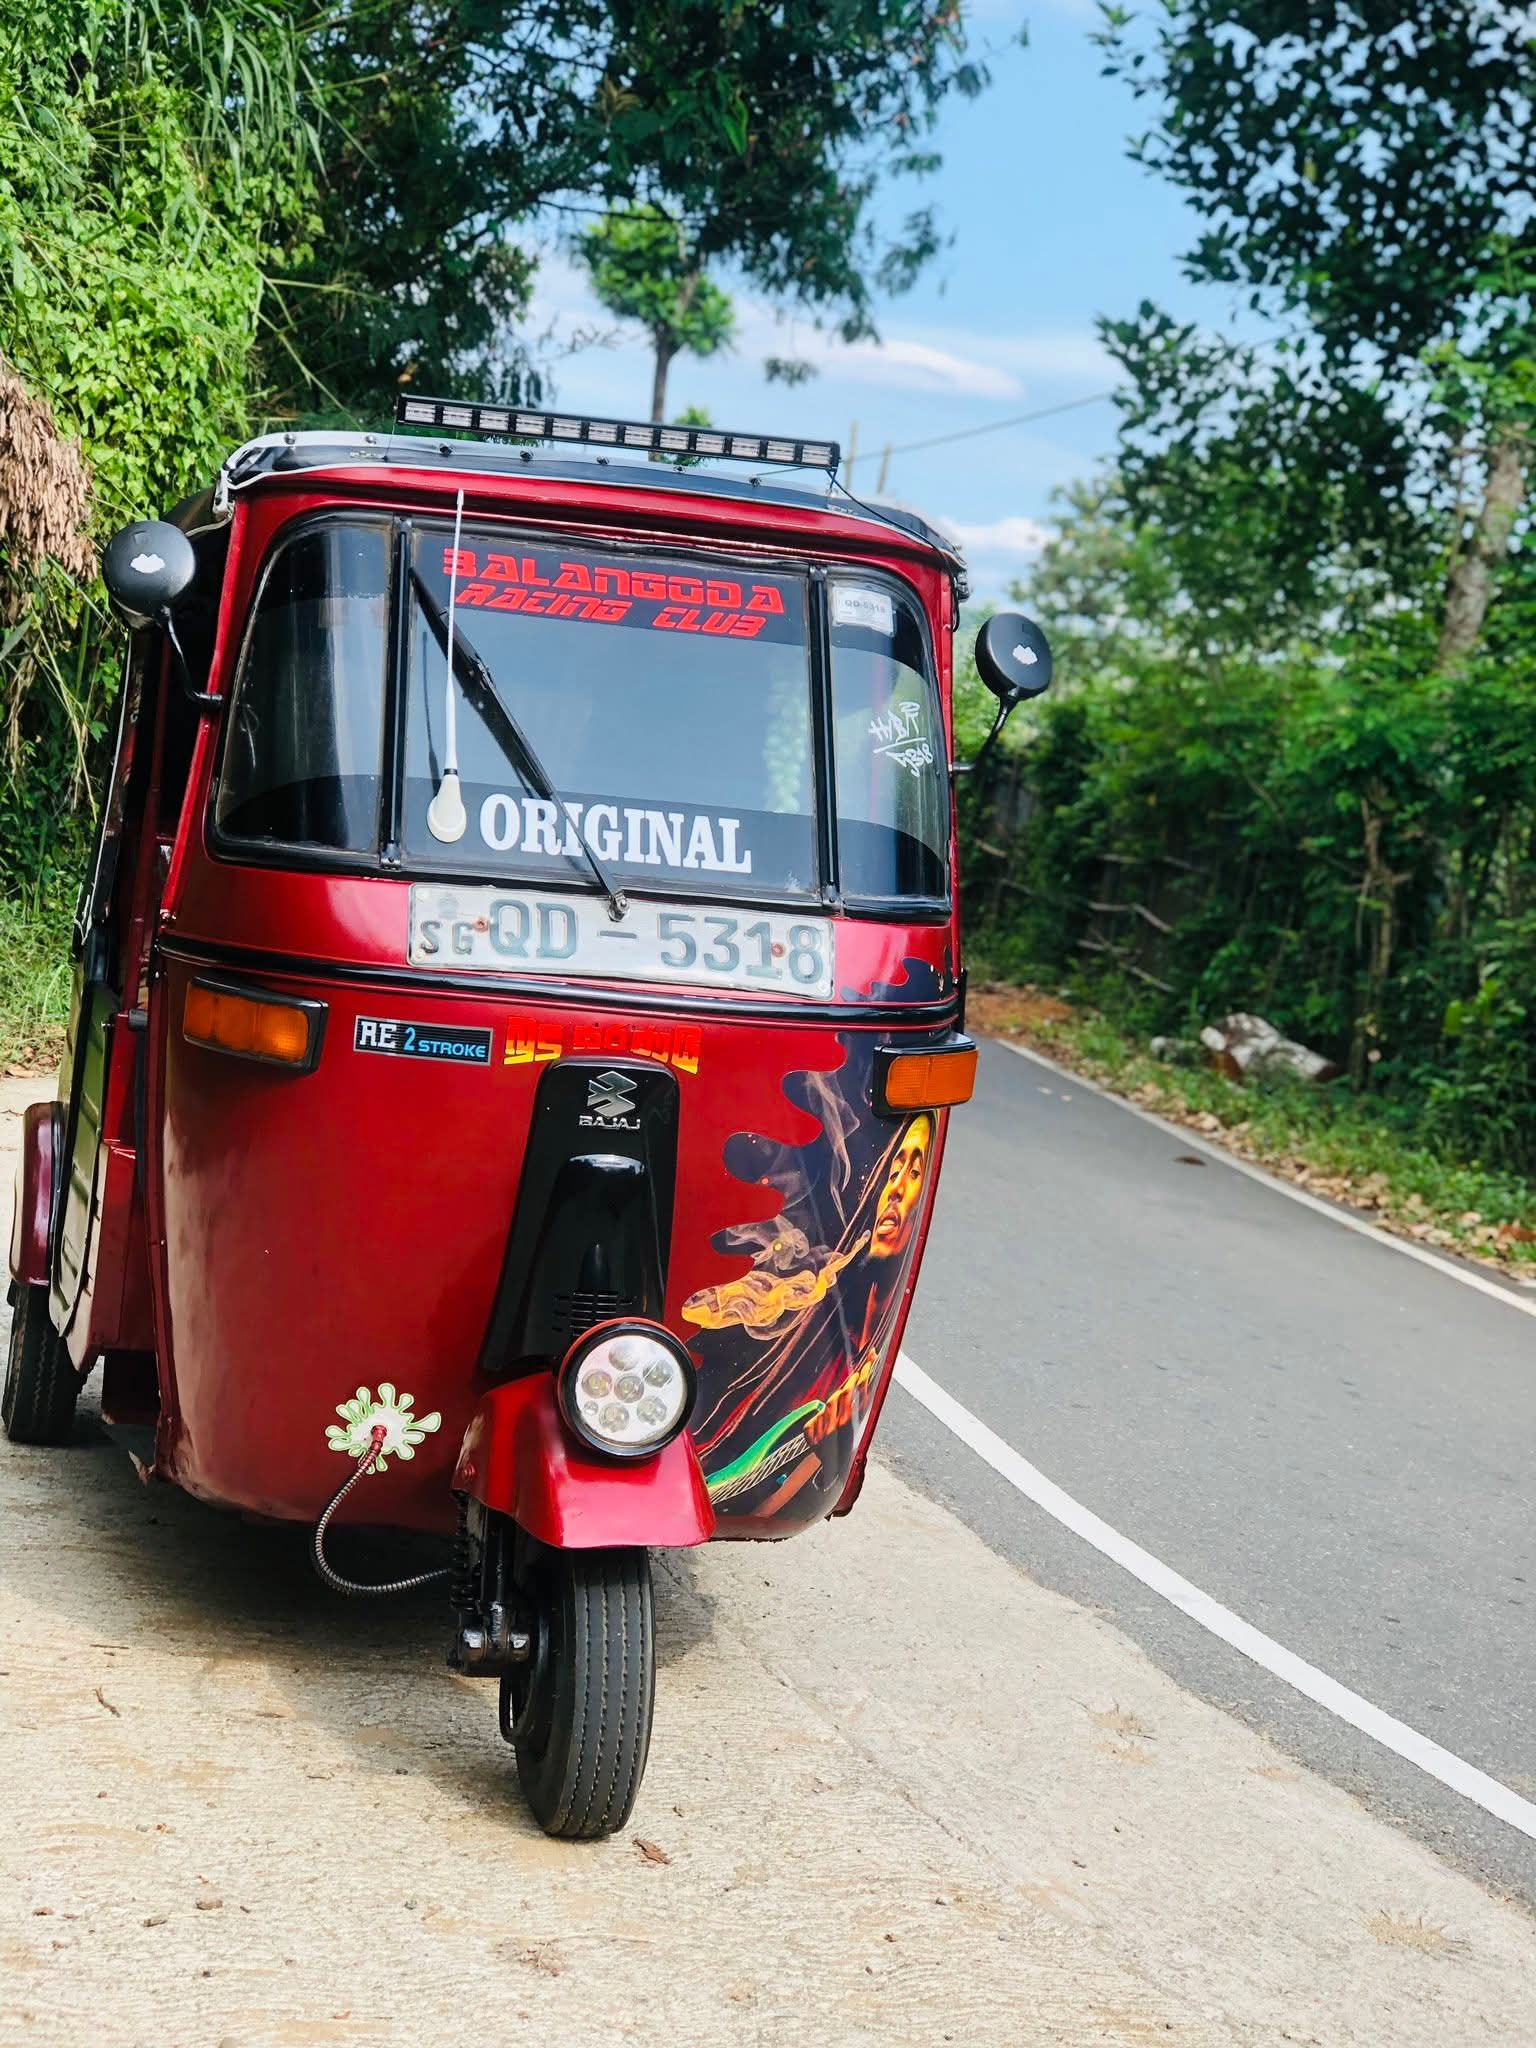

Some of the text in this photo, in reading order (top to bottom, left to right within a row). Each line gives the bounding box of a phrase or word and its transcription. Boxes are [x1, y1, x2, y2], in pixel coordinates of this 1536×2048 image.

[443, 547, 785, 613] BALANGODA
[455, 583, 768, 639] RACING CLUB
[480, 794, 752, 873] ORIGINAL
[359, 1020, 398, 1049] RE
[403, 1026, 417, 1051] 2
[418, 1039, 487, 1058] STROKE
[578, 1114, 641, 1131] BAJAJ
